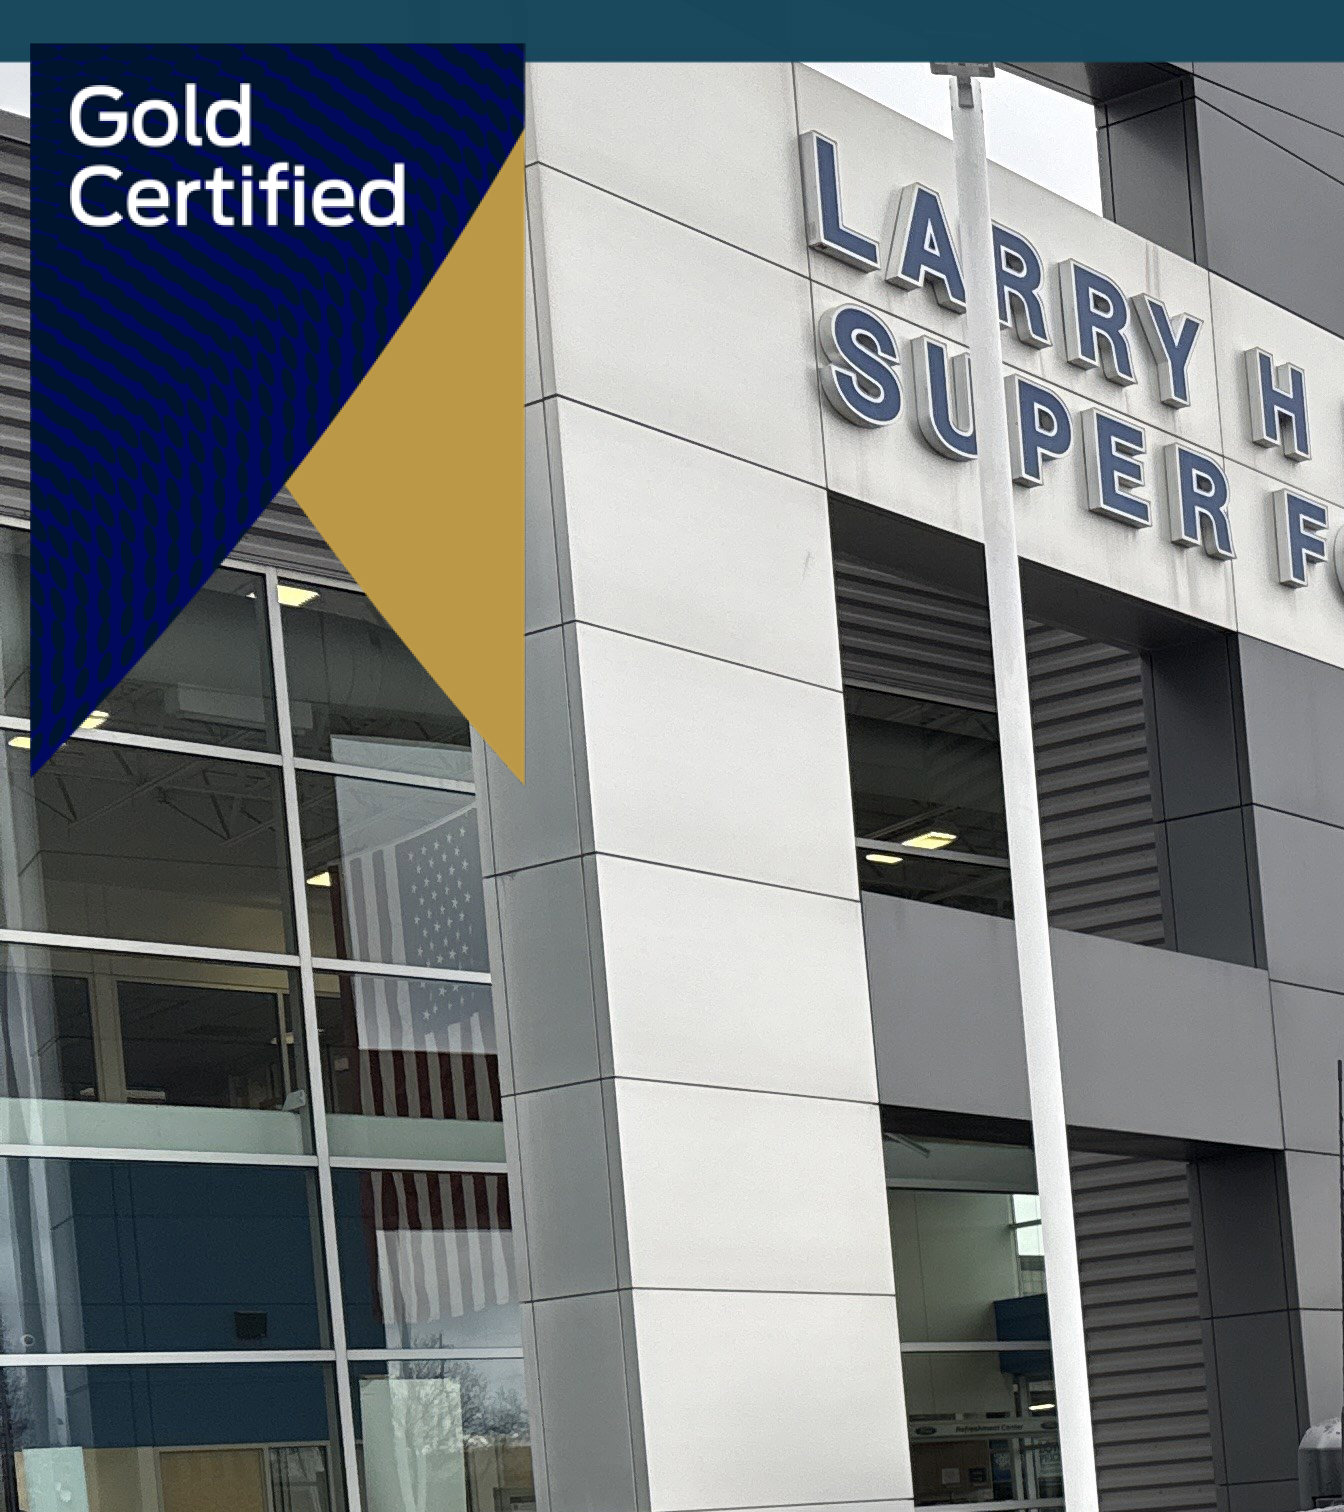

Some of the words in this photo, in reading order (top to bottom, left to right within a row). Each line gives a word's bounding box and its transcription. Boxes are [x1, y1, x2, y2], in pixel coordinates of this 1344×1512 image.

[799, 130, 1205, 410] LARRY
[1244, 346, 1312, 462] H
[819, 302, 1238, 563] SUPER
